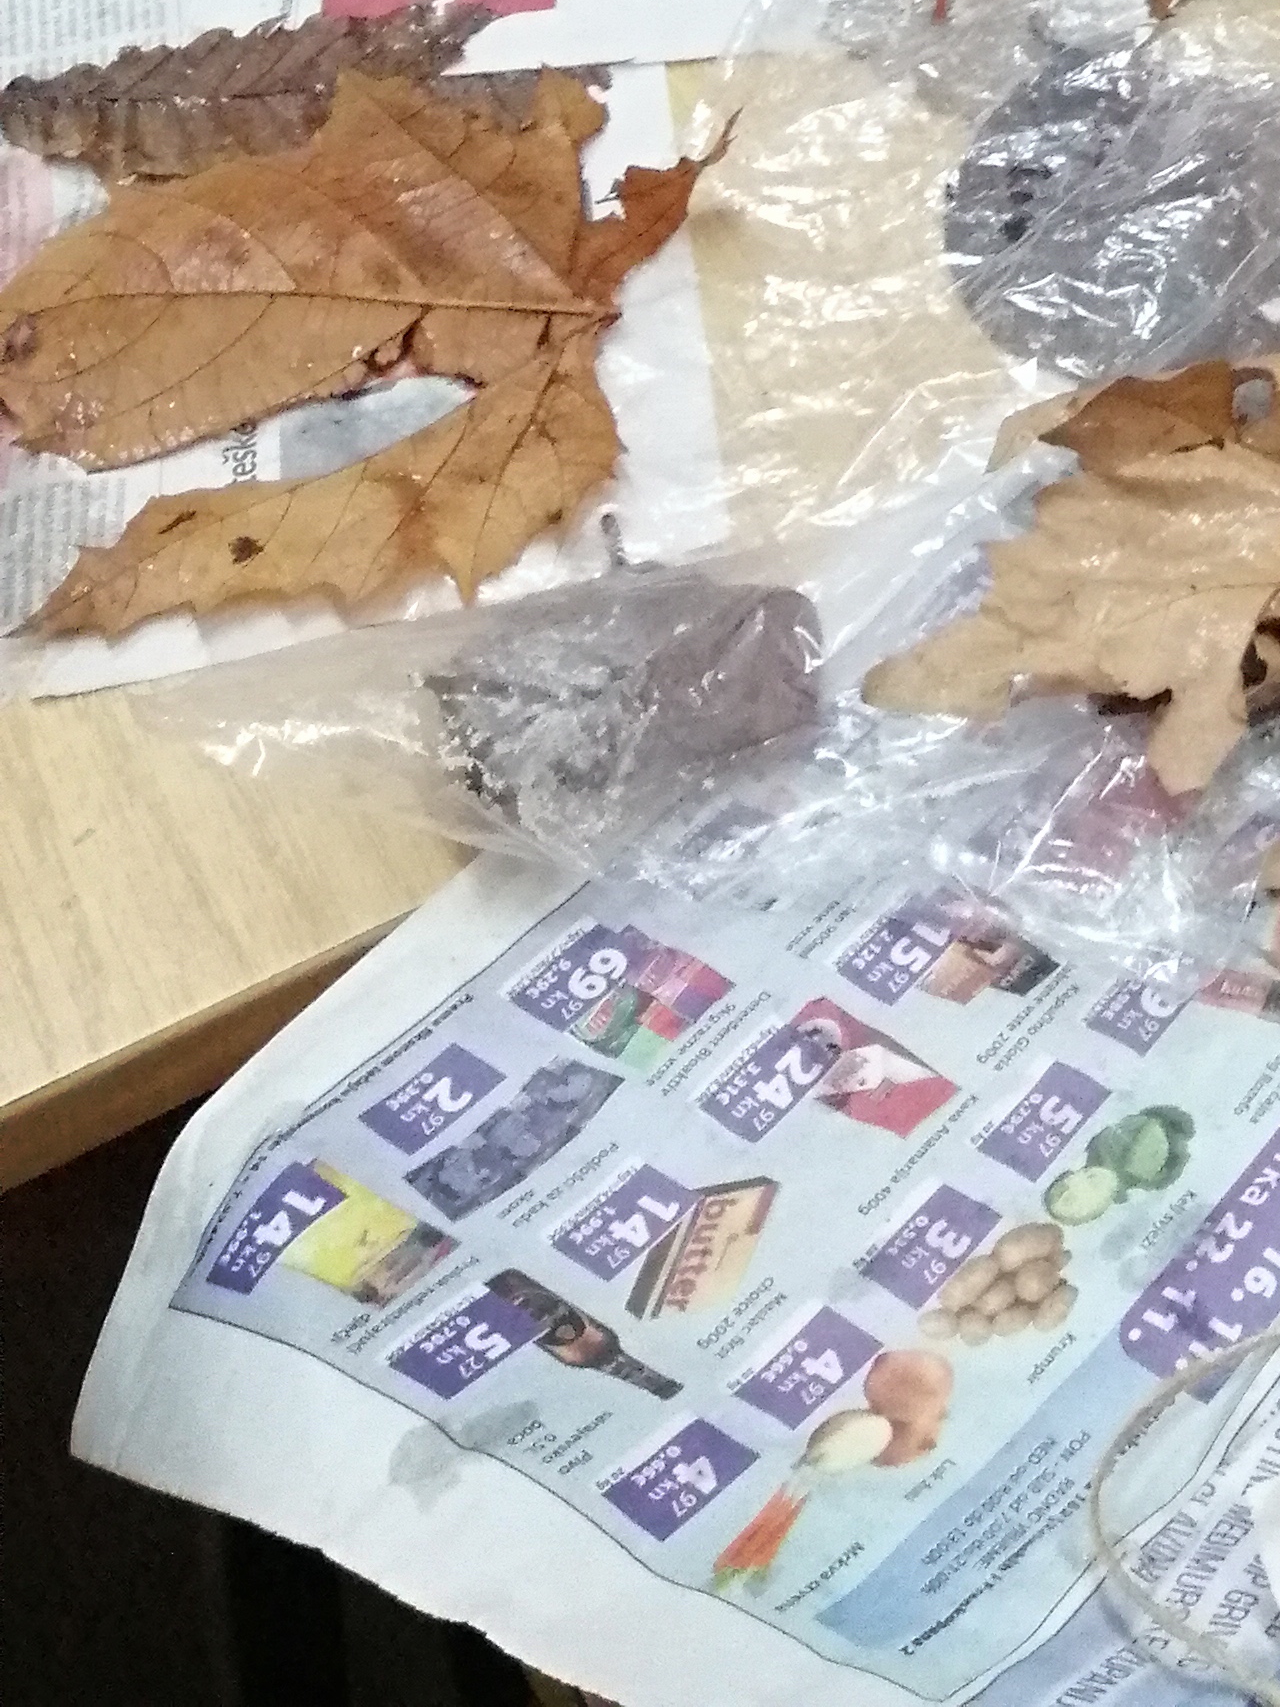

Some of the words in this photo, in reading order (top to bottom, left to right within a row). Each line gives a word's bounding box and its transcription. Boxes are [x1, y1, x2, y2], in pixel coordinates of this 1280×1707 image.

[885, 910, 948, 977] 15
[562, 940, 630, 1006] 69
[974, 1028, 1011, 1067] 200g
[422, 1070, 472, 1120] 2
[751, 1042, 820, 1115] 24
[945, 1091, 979, 1126] Kava
[1037, 1092, 1082, 1138] 5
[887, 1121, 951, 1188] Anamarija
[248, 1179, 326, 1254] 14
[607, 1182, 681, 1254] 14
[922, 1215, 971, 1263] 3
[1181, 1205, 1253, 1284] 22.
[658, 1190, 740, 1315] butter
[730, 1274, 777, 1320] choice
[1125, 1276, 1197, 1354] 11.
[460, 1316, 510, 1366] 5
[695, 1313, 736, 1353] 200g
[1021, 1328, 1078, 1389] Krumpir
[1172, 1308, 1242, 1386] 11.
[799, 1341, 848, 1390] 4
[555, 1446, 592, 1480] Pivo
[670, 1448, 723, 1501] 4
